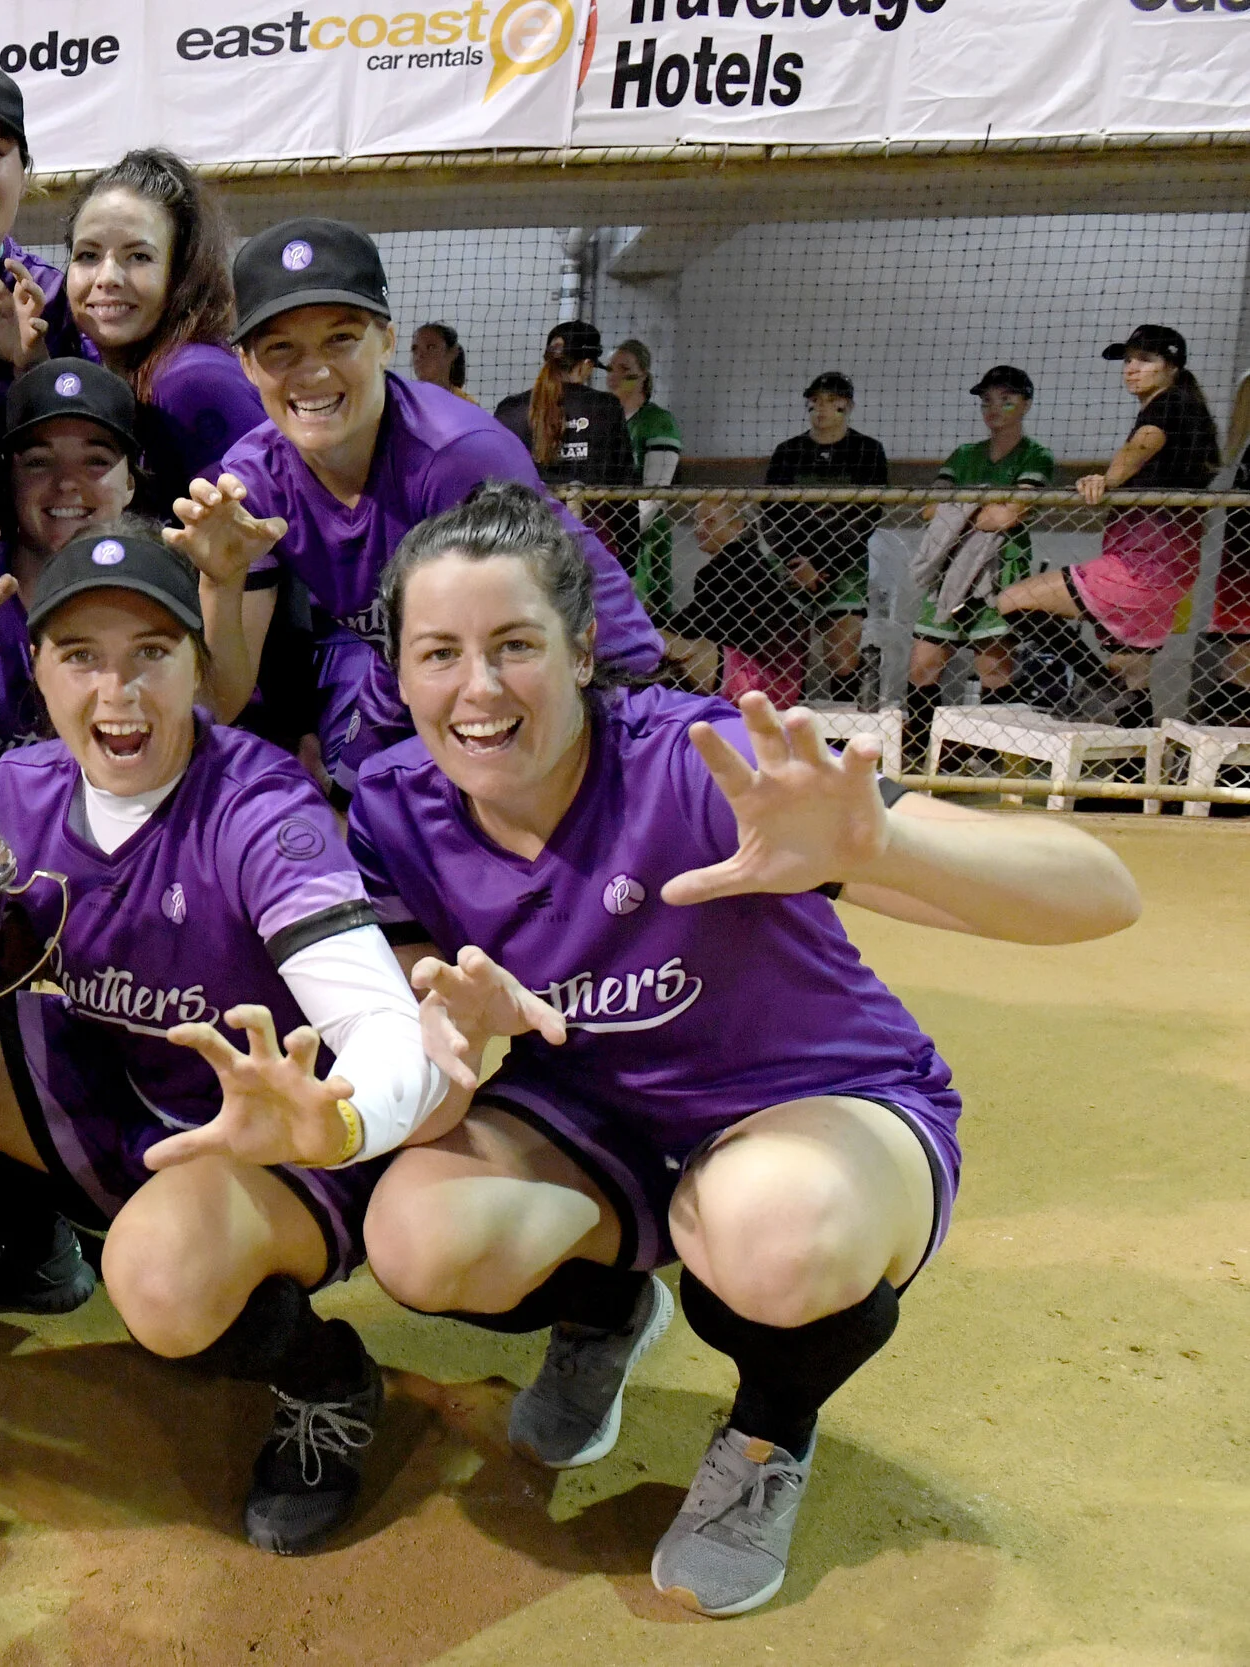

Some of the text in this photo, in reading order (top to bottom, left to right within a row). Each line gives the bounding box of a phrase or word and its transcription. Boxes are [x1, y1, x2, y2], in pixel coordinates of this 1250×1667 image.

[177, 0, 490, 60] eastcoast
[367, 46, 483, 71] car rentals
[610, 34, 804, 109] Hotels
